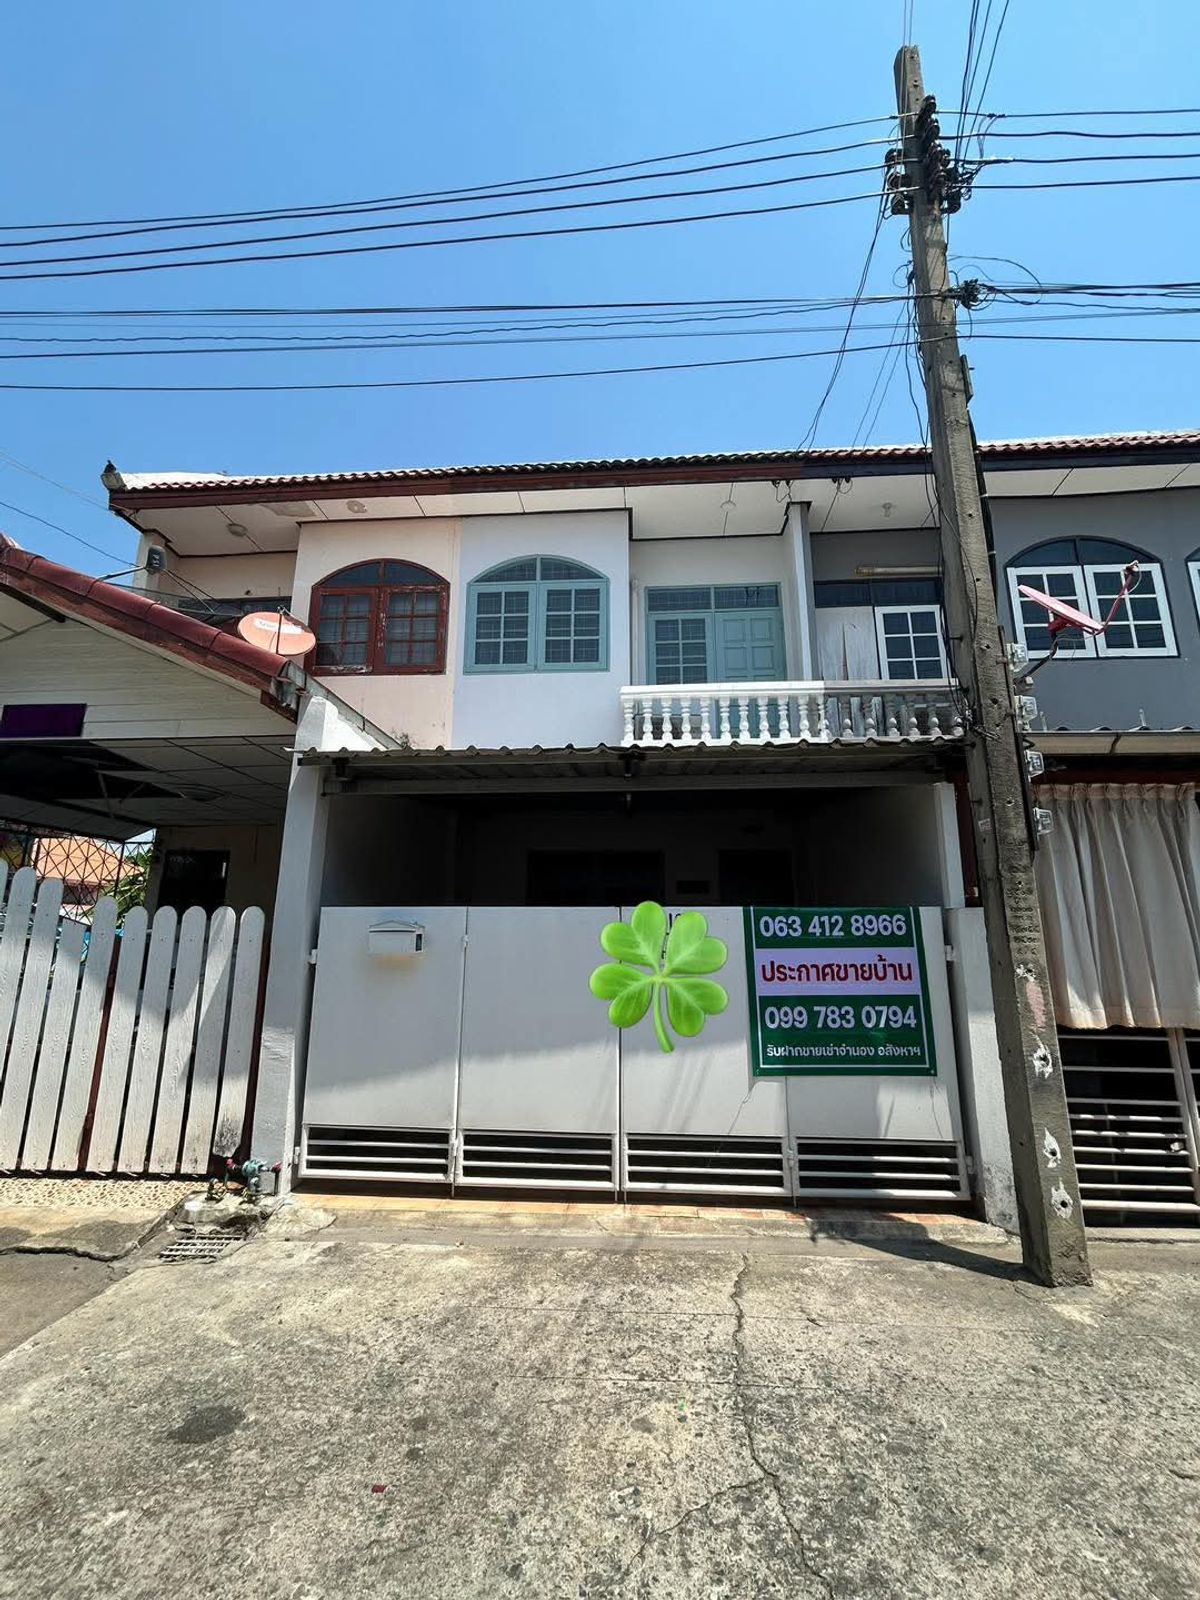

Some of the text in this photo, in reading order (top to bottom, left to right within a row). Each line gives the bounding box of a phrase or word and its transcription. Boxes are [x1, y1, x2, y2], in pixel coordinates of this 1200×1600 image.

[760, 914, 907, 937] 063 412 8966
[761, 954, 913, 982] ประกาศขายบ้าน
[765, 1005, 917, 1029] 099 783 0794
